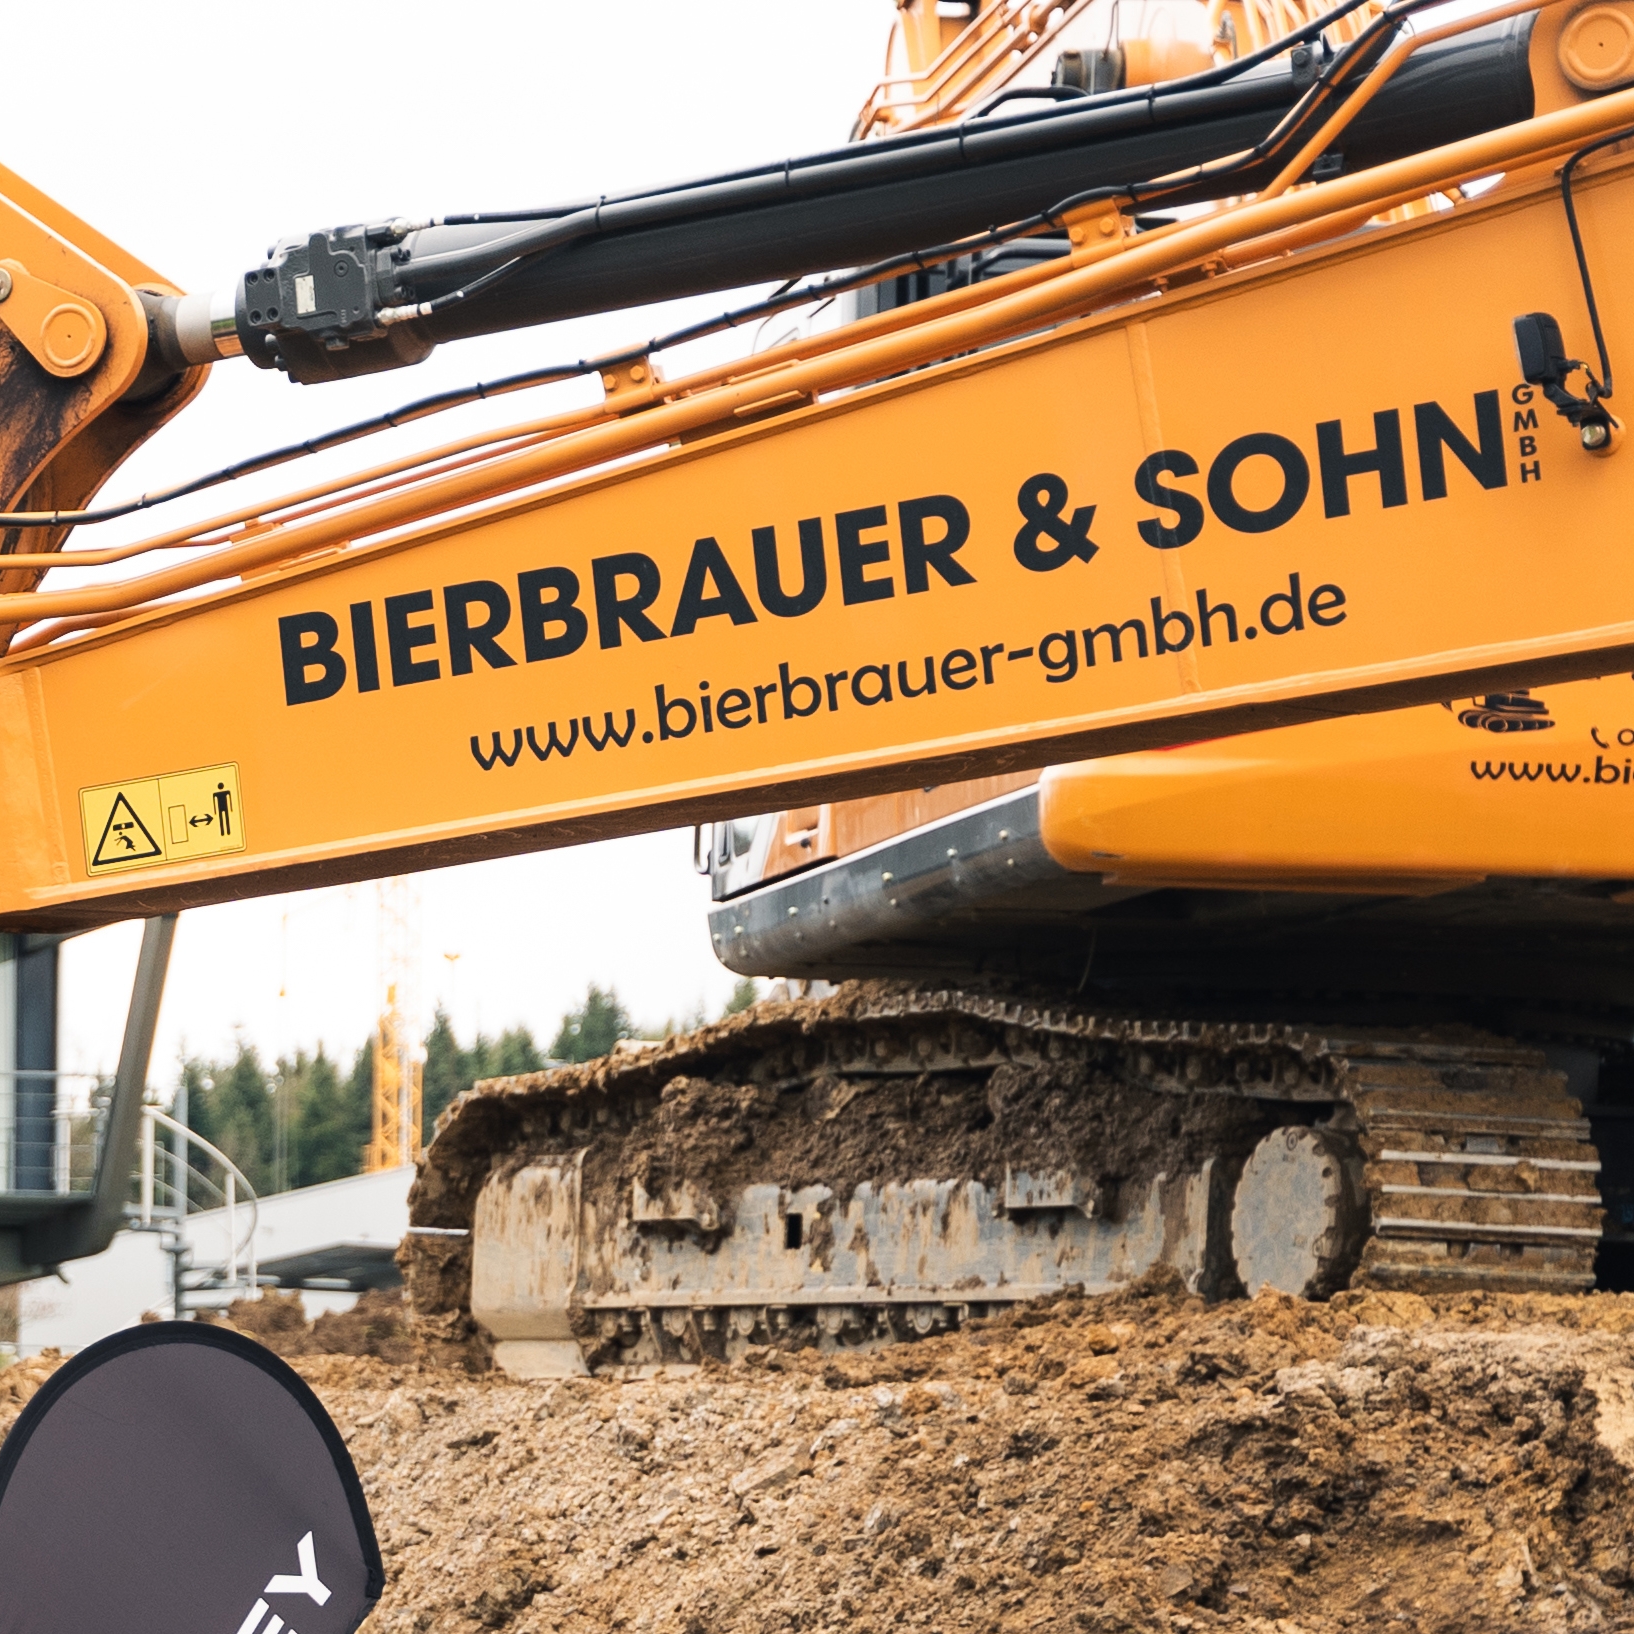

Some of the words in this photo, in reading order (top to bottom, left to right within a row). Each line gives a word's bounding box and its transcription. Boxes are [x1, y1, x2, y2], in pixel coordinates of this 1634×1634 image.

[277, 494, 978, 707] BIERBRAUER
[1013, 472, 1100, 573] &
[1133, 389, 1509, 550] SOHN
[469, 572, 1348, 772] www.bierbrauer-gmbh.de
[1470, 755, 1634, 785] www.bi
